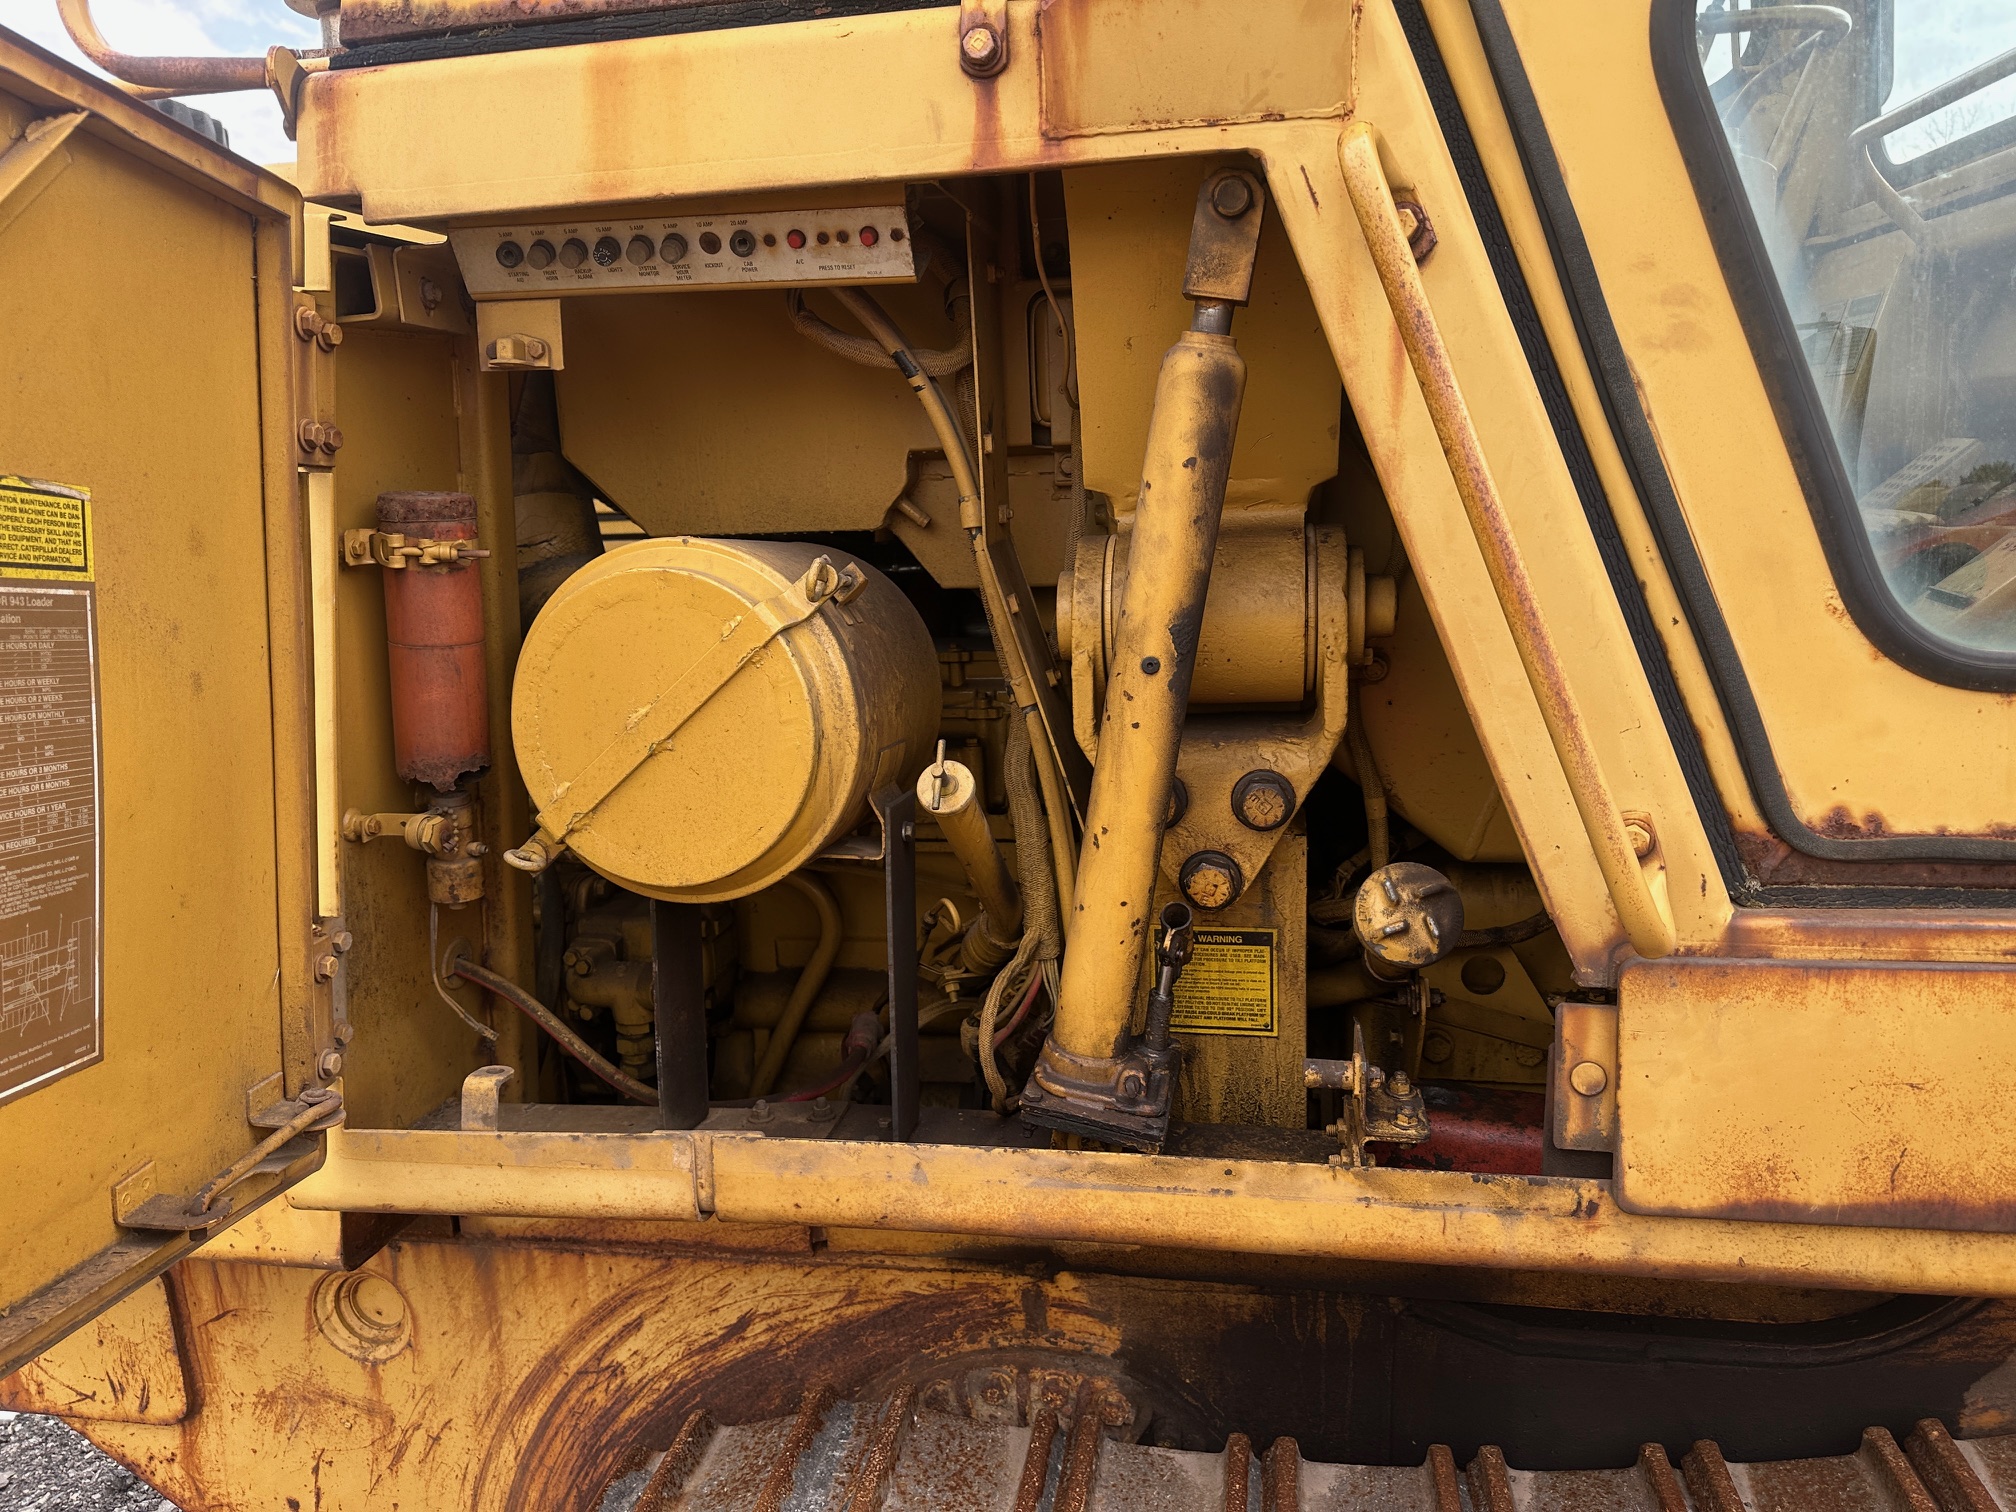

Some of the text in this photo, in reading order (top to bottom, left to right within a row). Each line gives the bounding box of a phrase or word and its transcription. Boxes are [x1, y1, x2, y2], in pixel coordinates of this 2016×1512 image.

[4, 505, 18, 513] THIS
[19, 507, 46, 517] MACHINE
[27, 517, 42, 525] EACH
[43, 519, 65, 528] PERSON
[66, 521, 81, 529] MUST
[11, 525, 45, 535] NECESSARY
[46, 528, 62, 536] SKILL
[8, 535, 44, 544] EQUIPMENT,
[44, 537, 57, 545] AND
[58, 538, 72, 546] THAT
[20, 545, 59, 554] CATERPILLAR
[58, 547, 83, 556] DEALERS
[9, 596, 25, 607] 943
[26, 597, 54, 607] Loader
[6, 642, 28, 650] HOURS
[38, 641, 55, 649] DAILY
[4, 679, 26, 687] HOURS
[5, 696, 27, 705] HOURS
[28, 695, 37, 703] OR
[43, 694, 64, 702] WEEKS
[4, 713, 27, 722] HOURS
[27, 712, 37, 720] OR
[37, 711, 65, 719] MONTHLY
[6, 768, 28, 778] HOURS
[28, 767, 38, 775] OR
[43, 763, 69, 773] MONTHS
[8, 785, 30, 795] HOURS
[30, 784, 40, 792] OR
[45, 779, 70, 789] MONTHS
[14, 807, 36, 817] HOURS
[36, 806, 46, 814] OR
[50, 802, 67, 811] YEAR
[5, 837, 37, 849] REQUIRED
[1197, 934, 1243, 944] WARNING
